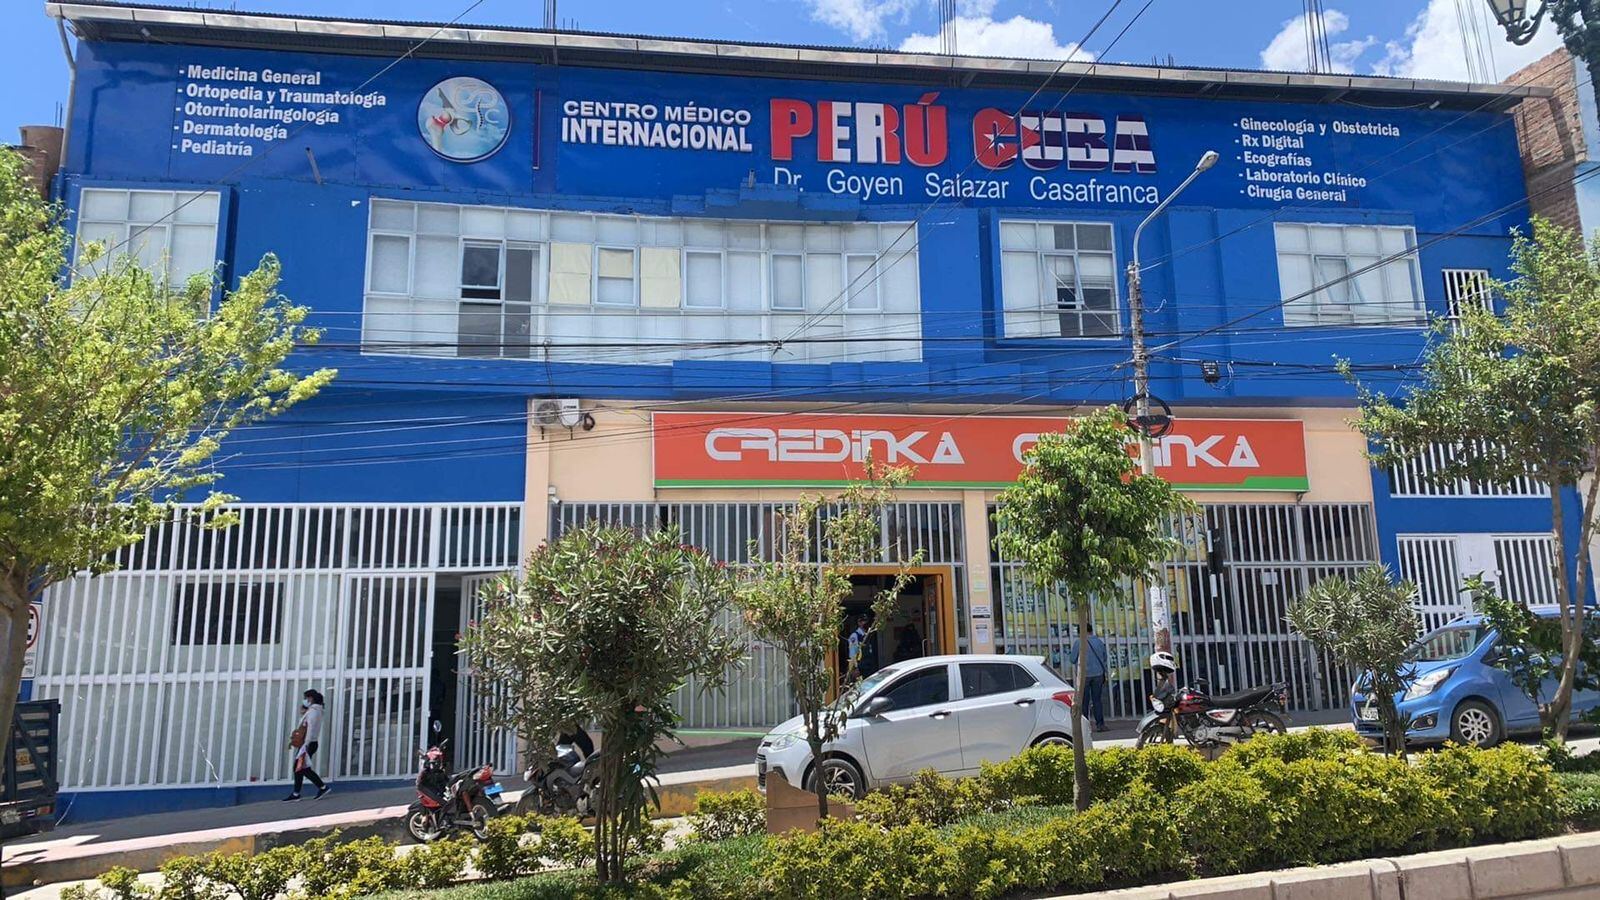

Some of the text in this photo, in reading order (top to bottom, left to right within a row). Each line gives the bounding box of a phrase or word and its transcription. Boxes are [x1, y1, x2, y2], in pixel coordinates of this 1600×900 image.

[187, 65, 320, 85] Medicina General
[187, 83, 386, 108] Ortopedia y Traumatología
[563, 100, 752, 125] CENTRO MÉDICO
[183, 120, 288, 141] Dermatología
[562, 117, 752, 151] INTERNACIONAL
[770, 92, 1157, 173] PERÚ CUBA
[1240, 118, 1400, 137] Ginecología y Obstetricia
[182, 139, 253, 156] Pediatría
[1242, 134, 1304, 150] Rx Digital
[1244, 151, 1312, 167] Ecografías
[774, 167, 1159, 204] Dr. Goyen Salazar Casafranca
[1246, 168, 1367, 187] Laboratorio Clínico
[1247, 184, 1346, 201] Cirugía General
